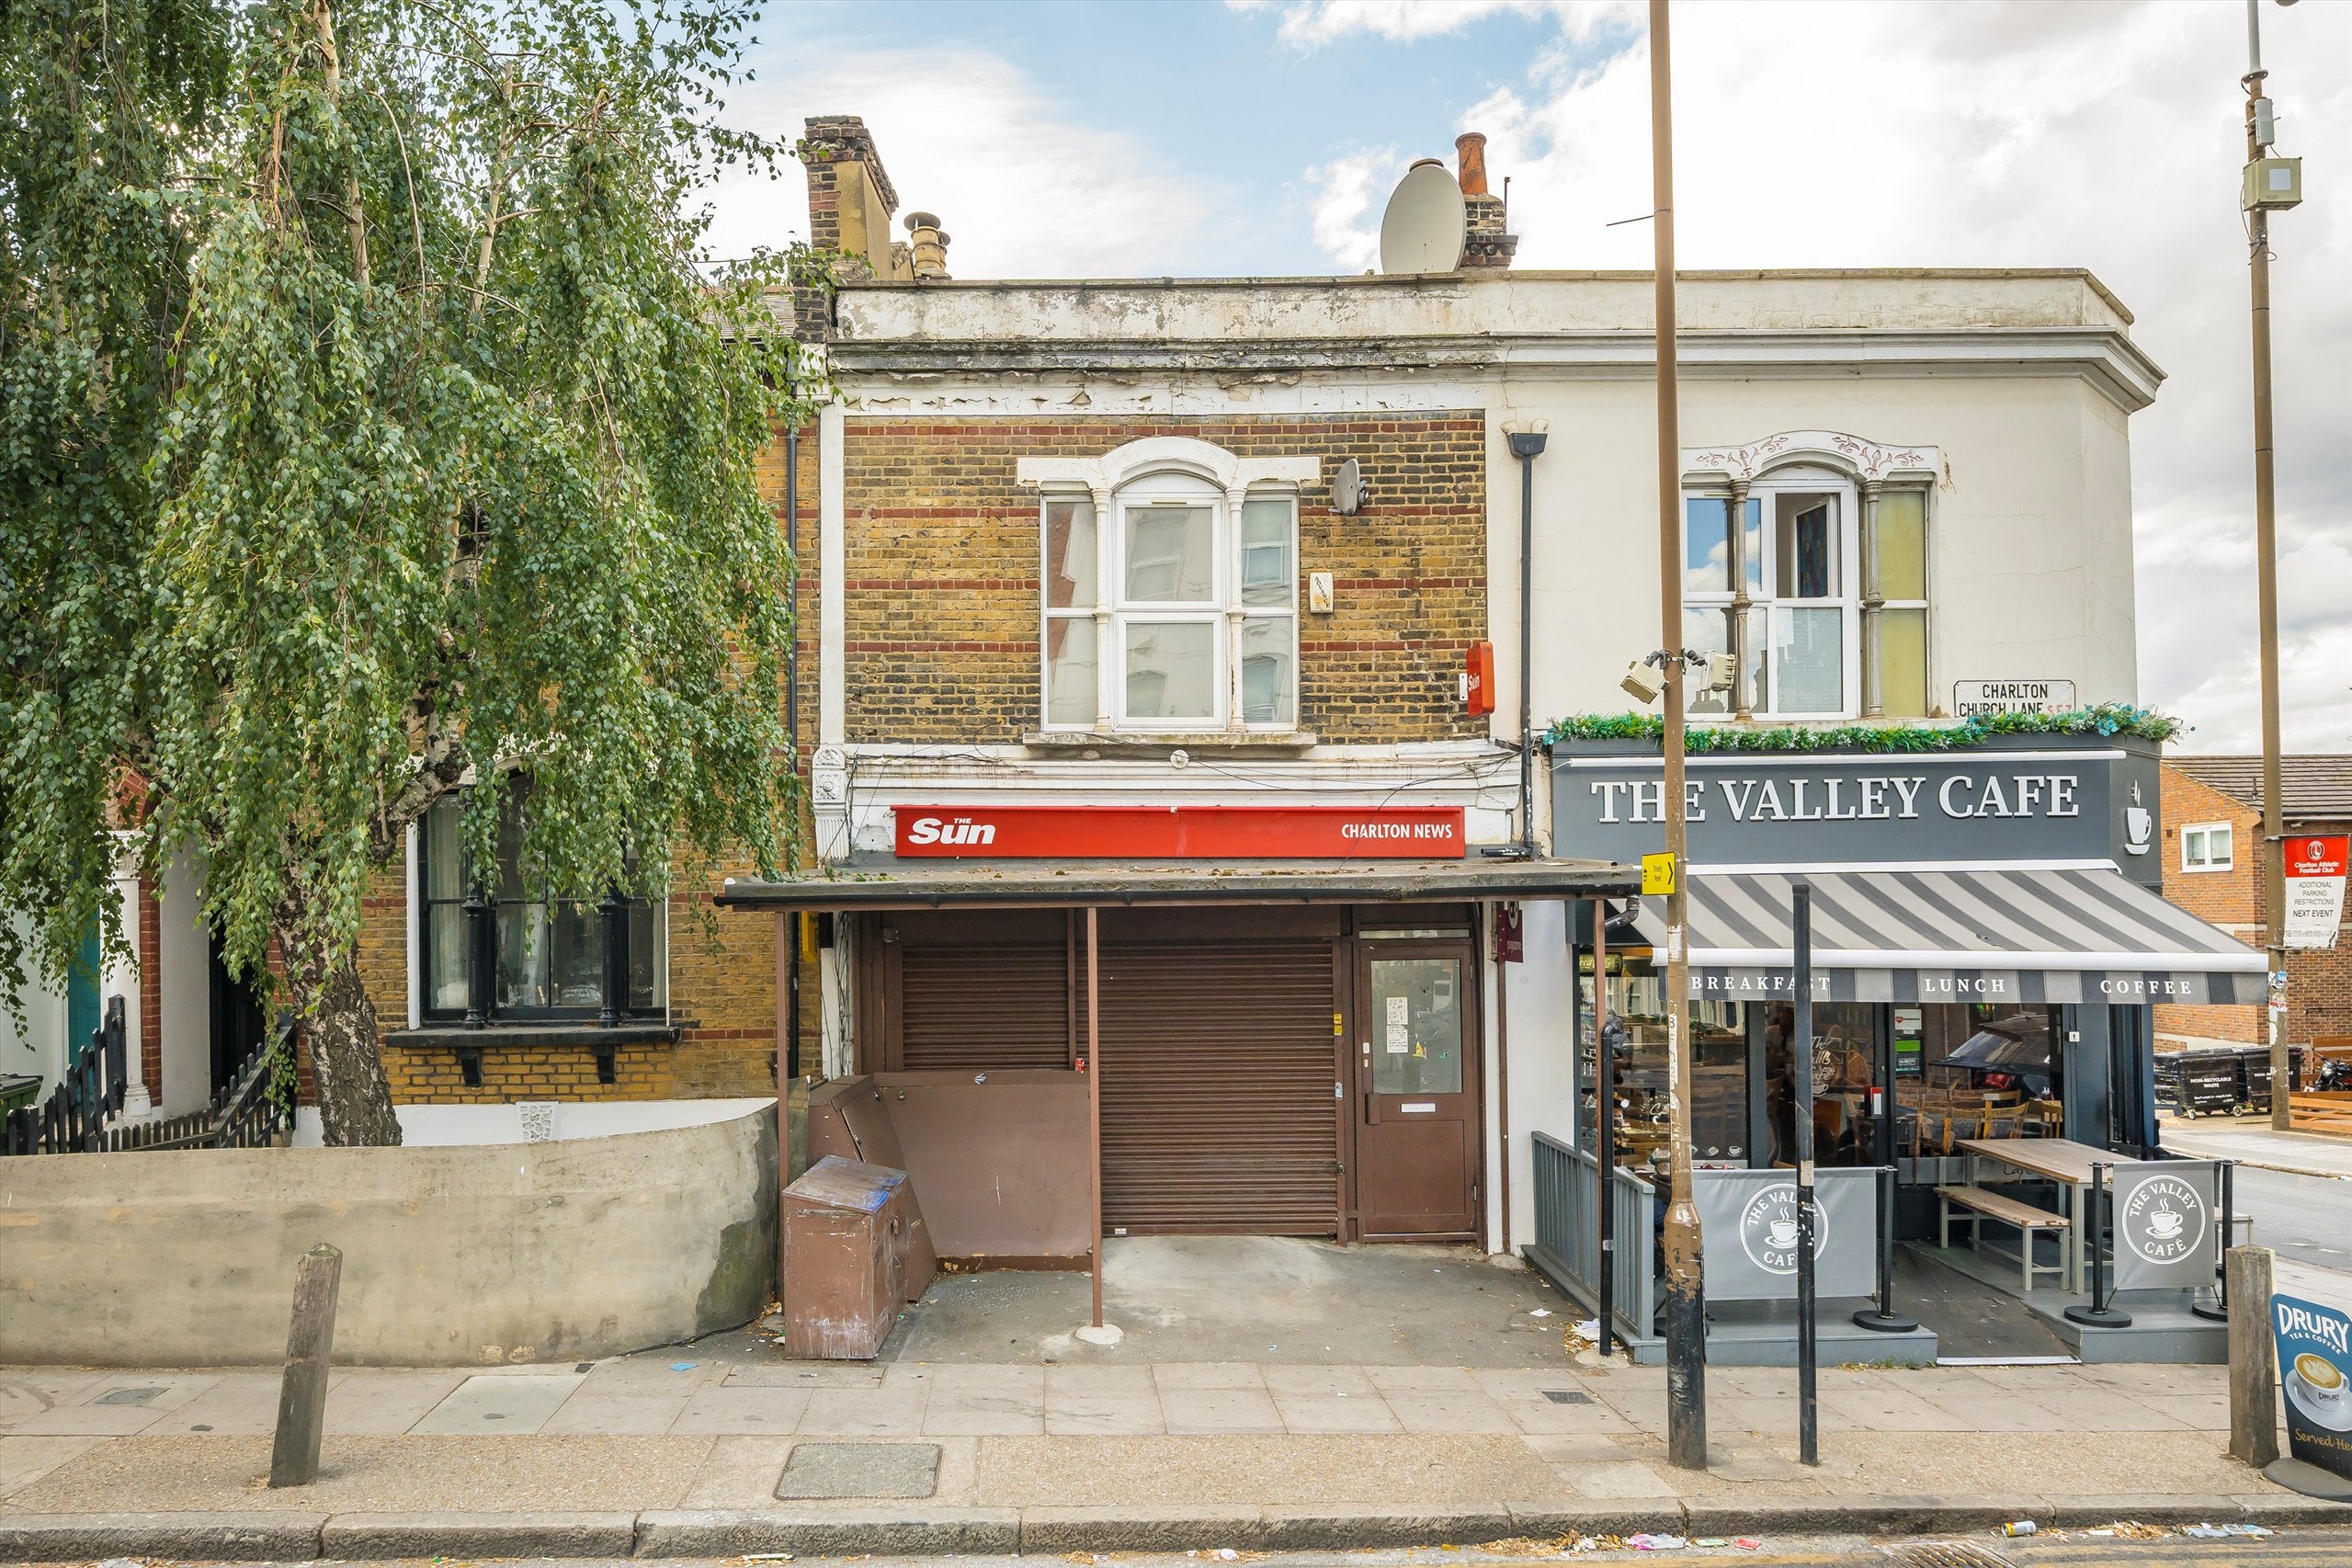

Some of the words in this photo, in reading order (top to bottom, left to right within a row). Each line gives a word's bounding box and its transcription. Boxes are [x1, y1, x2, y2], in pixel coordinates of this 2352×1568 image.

[1983, 684, 2048, 699] CHARLTON
[1959, 702, 2006, 717] CHURCH
[1590, 780, 1706, 824] THE
[1717, 777, 1926, 822] VALLEY
[1938, 775, 2079, 819] CAFE
[908, 817, 996, 845] Sun
[1341, 824, 1411, 839] CHARLTON
[1414, 824, 1453, 839] NEWS
[2298, 881, 2333, 889] ADDITIONAL
[2302, 889, 2327, 897] PARKING
[2292, 909, 2310, 918] NEXT
[2312, 909, 2335, 918] EVENT
[1690, 976, 1830, 991] BREAKFAT
[1925, 978, 2005, 993] LUNCH
[2100, 980, 2192, 994] COFFEE
[2129, 1190, 2151, 1218] THE
[2149, 1183, 2198, 1210] VALLEY
[1747, 1199, 1769, 1226] THE
[2144, 1238, 2187, 1256] CAFÉ
[1763, 1251, 1798, 1267] CAF
[2277, 1302, 2349, 1354] DRURY
[2289, 1333, 2303, 1341] TEA
[2312, 1335, 2342, 1356] COFFEE
[2294, 1428, 2335, 1448] Served
[2335, 1437, 2352, 1451] He
